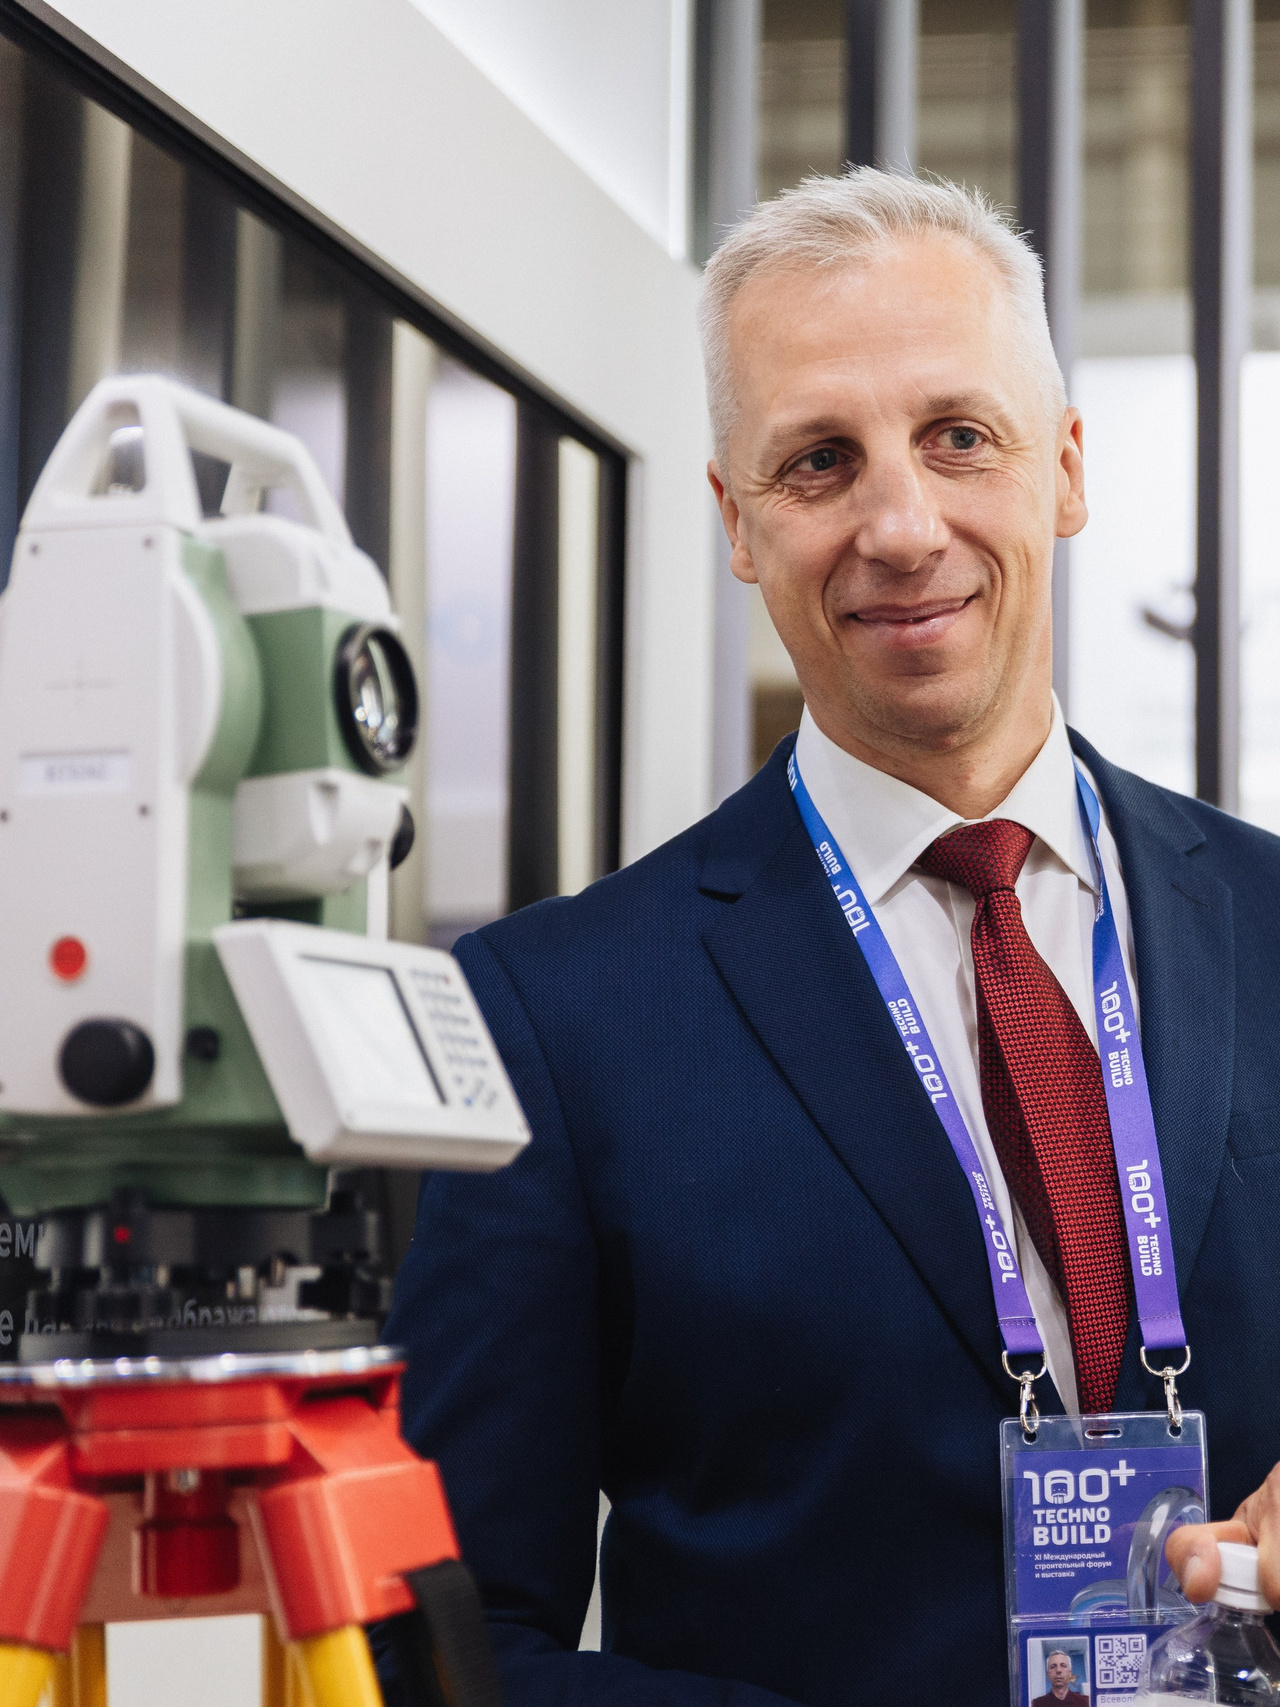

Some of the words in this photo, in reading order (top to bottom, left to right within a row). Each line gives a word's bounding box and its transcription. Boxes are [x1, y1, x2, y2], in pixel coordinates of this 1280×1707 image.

[819, 841, 842, 875] BUILD
[888, 1001, 910, 1036] TECHNO
[898, 998, 920, 1035] BUILD
[1100, 981, 1131, 1043] 100+
[906, 1041, 947, 1104] 100+
[1107, 1051, 1122, 1088] BUILD
[1120, 1048, 1133, 1086] TECHNO
[972, 1171, 988, 1209] TECHNO
[976, 1172, 994, 1211] BUILD
[1126, 1160, 1161, 1228] 100+
[984, 1214, 1017, 1283] 100+
[1137, 1235, 1152, 1276] BUILD
[1149, 1234, 1162, 1276] TECHNO
[1023, 1459, 1136, 1504] 100+
[1033, 1507, 1110, 1524] TECHNO
[1033, 1524, 1111, 1546] BUILD
[1034, 1561, 1085, 1570] строительный
[1086, 1560, 1112, 1569] форум
[1043, 1552, 1106, 1561] Международный
[1100, 1694, 1134, 1704] Всевол
